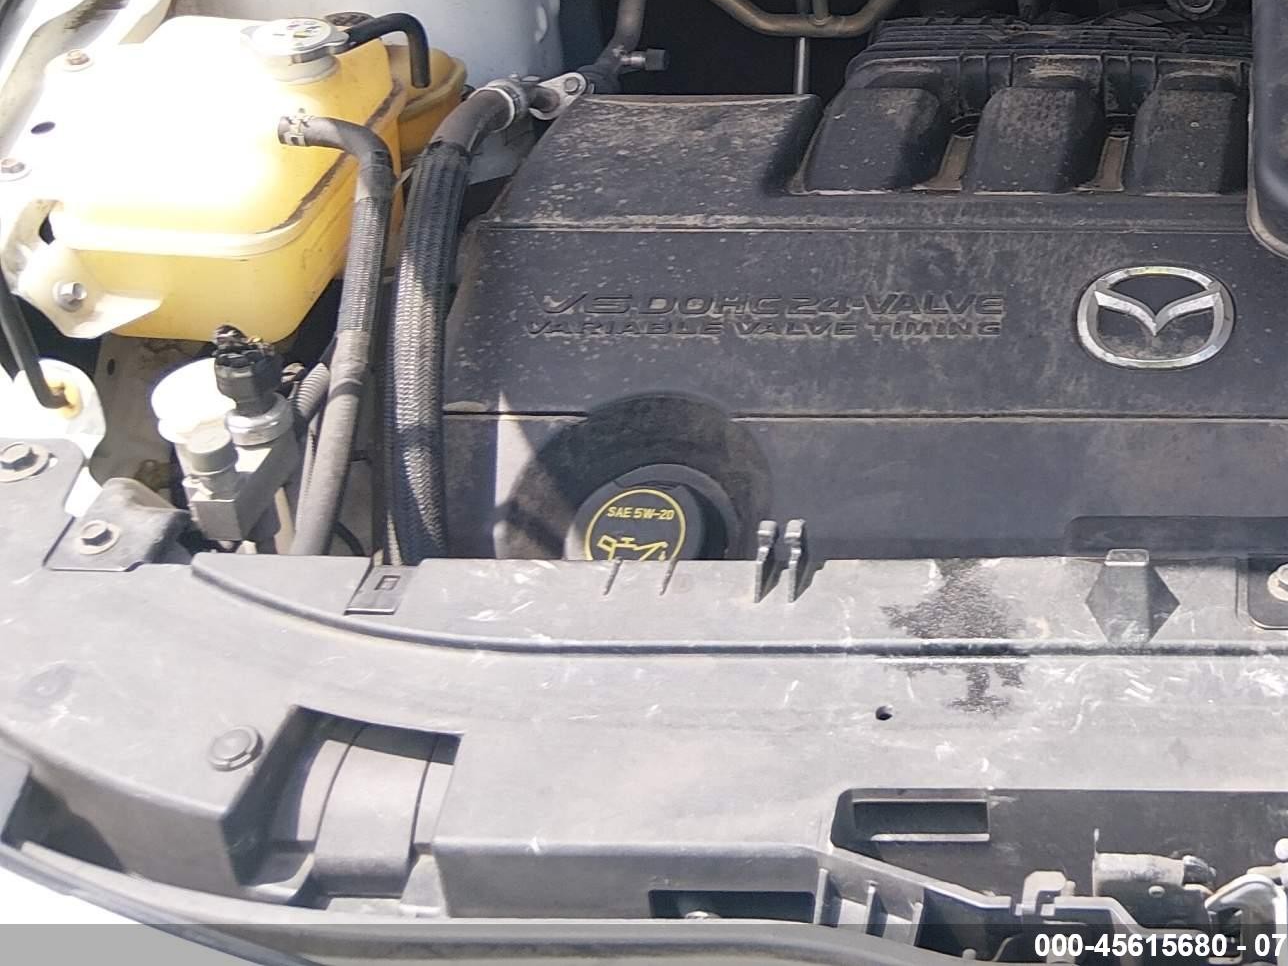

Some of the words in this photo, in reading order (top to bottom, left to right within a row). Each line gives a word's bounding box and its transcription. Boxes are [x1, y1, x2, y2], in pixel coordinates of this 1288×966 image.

[638, 295, 783, 316] DOHC
[786, 292, 1005, 316] 24-VALVE
[525, 320, 725, 336] VARIABLE
[733, 320, 857, 336] VALVE
[866, 321, 1001, 337] TIMING
[607, 506, 632, 518] SAE
[633, 507, 674, 520] 5W-20
